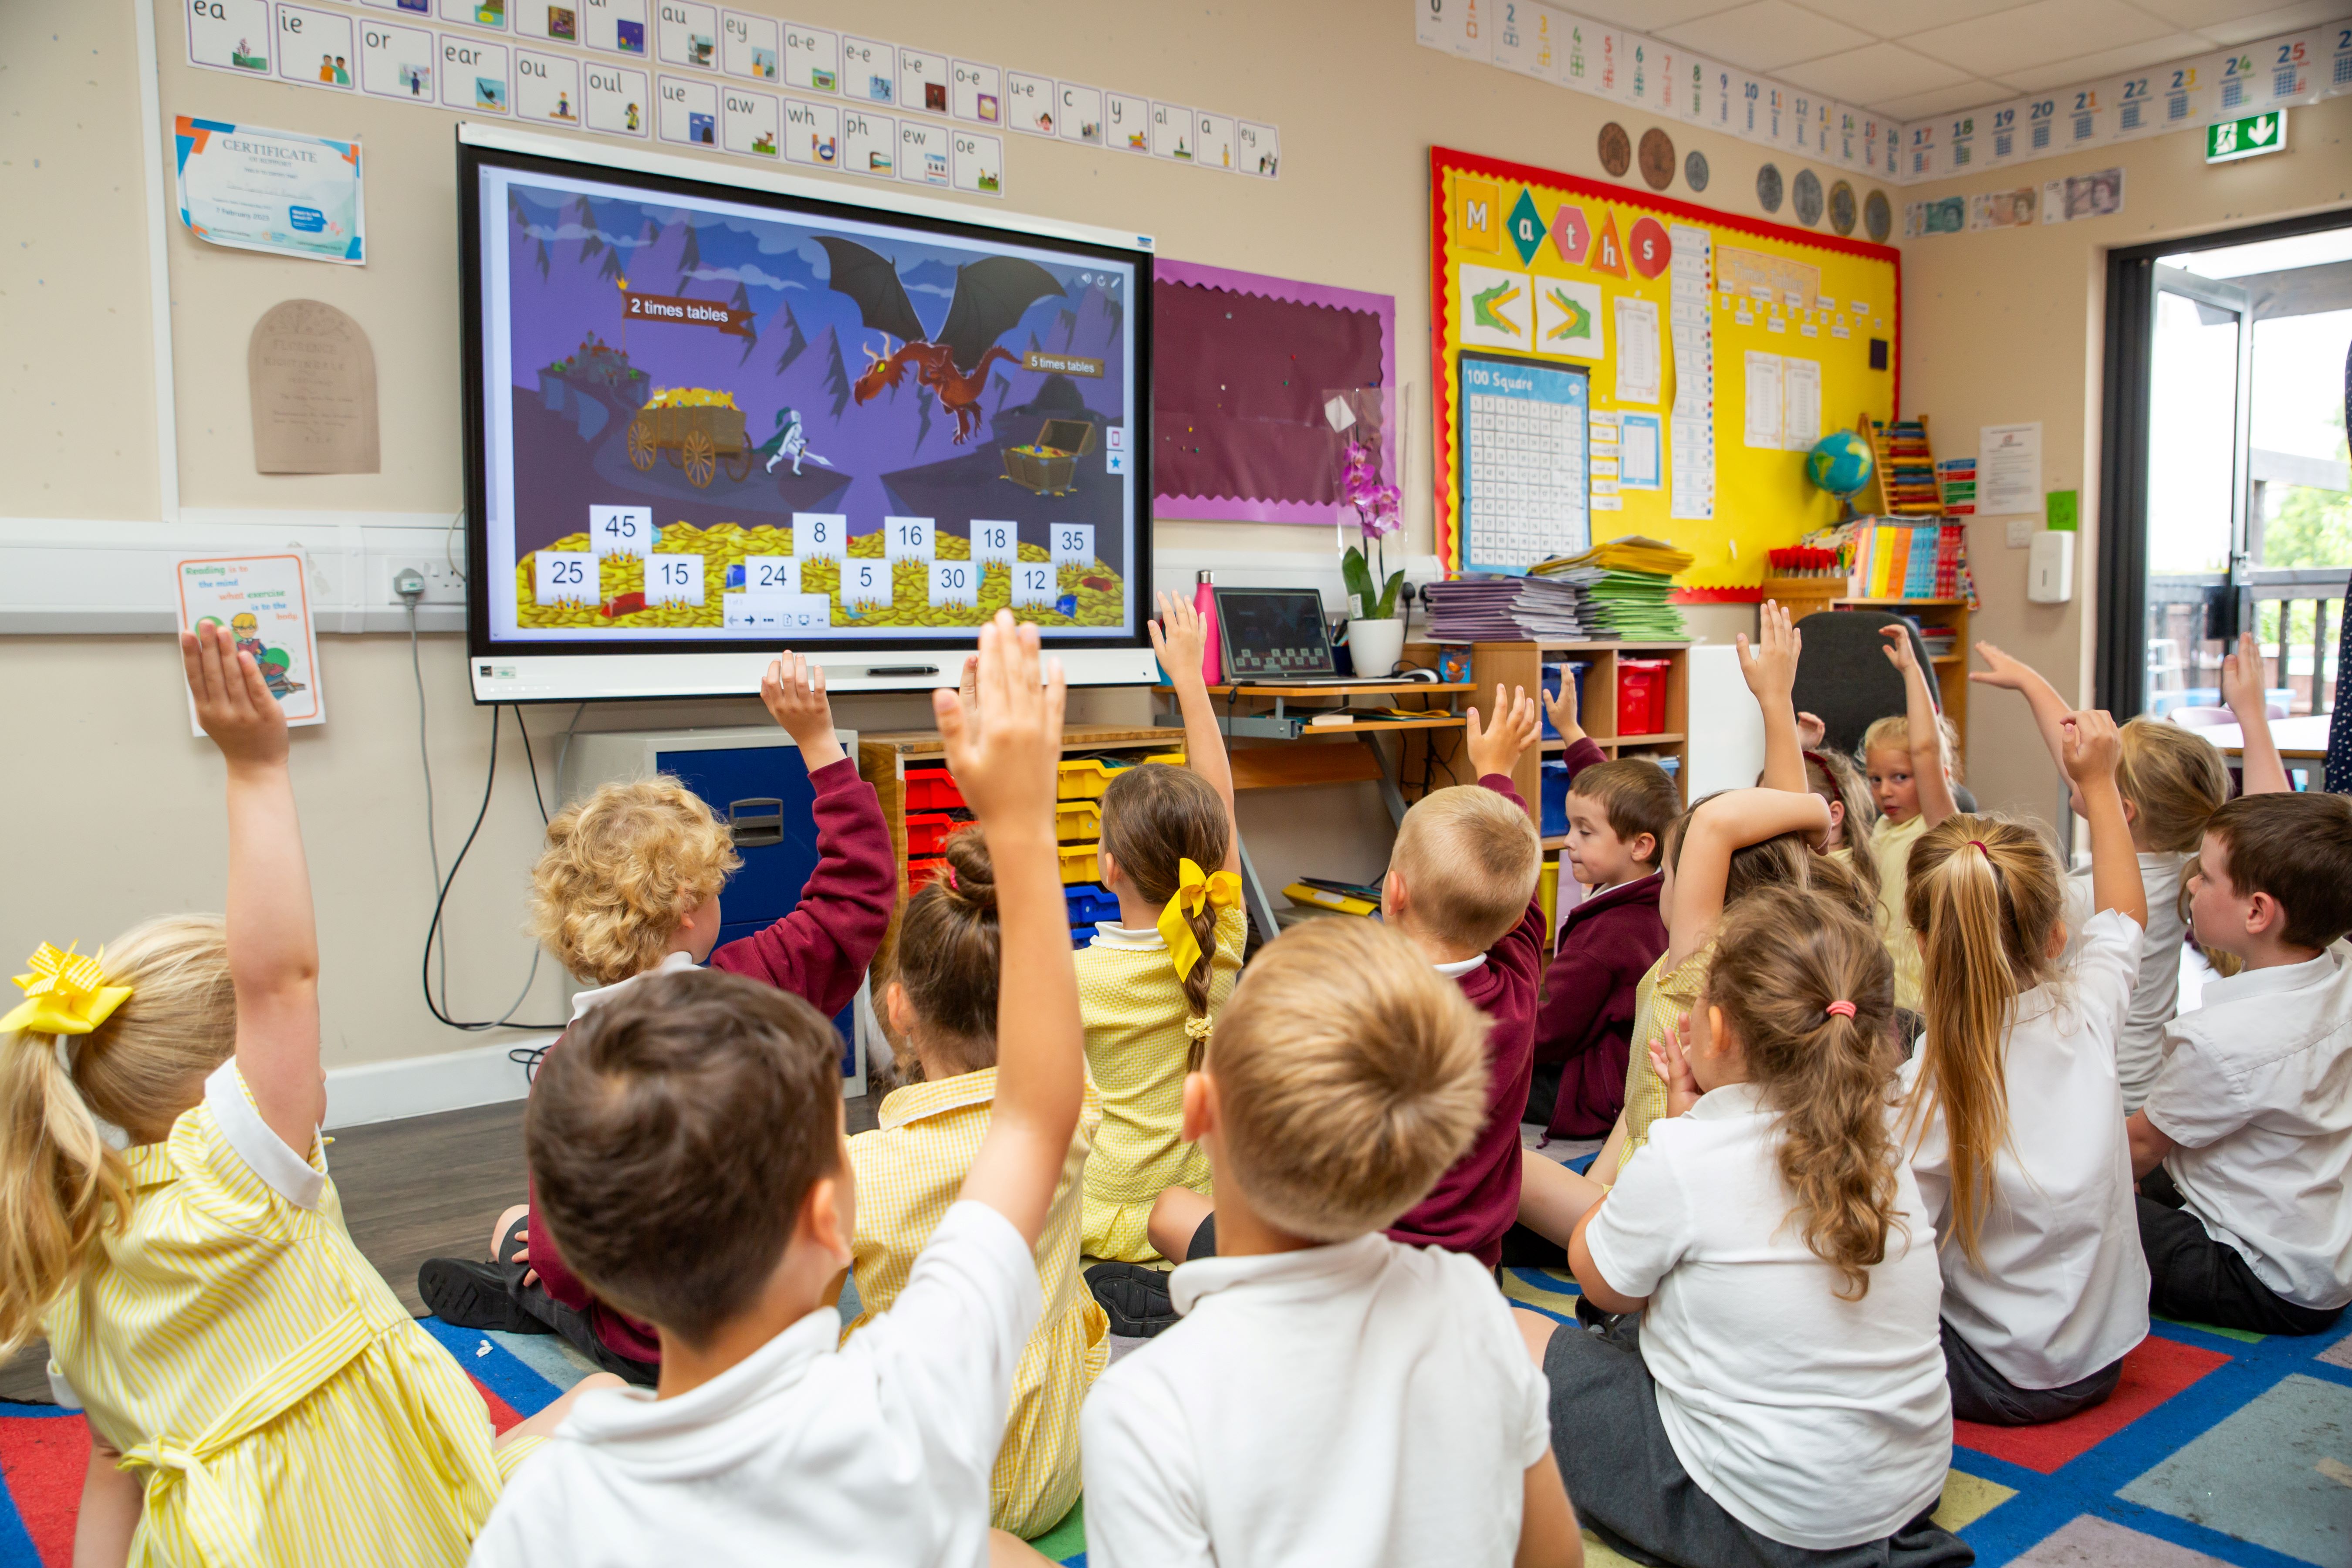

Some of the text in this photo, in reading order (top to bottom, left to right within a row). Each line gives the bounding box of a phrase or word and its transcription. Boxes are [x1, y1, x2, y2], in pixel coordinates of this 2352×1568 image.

[194, 0, 226, 20] ea
[662, 7, 688, 25] au
[1507, 3, 1515, 23] 2
[281, 10, 303, 34] ie
[726, 17, 747, 43] ey
[1541, 15, 1548, 34] 3
[365, 32, 391, 50] or
[788, 34, 815, 51] a-e
[1573, 26, 1581, 44] 4
[1605, 35, 1612, 54] 5
[2338, 30, 2352, 49] 2
[445, 46, 481, 66] ear
[846, 45, 871, 62] e-e
[1636, 45, 1644, 64] 6
[2277, 42, 2305, 63] 25
[520, 60, 547, 79] ou
[902, 53, 922, 73] i-e
[1664, 55, 1671, 72] 7
[1693, 64, 1700, 81] 8
[2225, 54, 2251, 76] 24
[590, 72, 623, 93] oul
[956, 69, 980, 85] o-e
[1720, 72, 1728, 89] 9
[2171, 68, 2196, 88] 23
[662, 84, 685, 103] ue
[1010, 81, 1034, 98] u-e
[1745, 81, 1758, 100] 10
[2123, 78, 2148, 99] 22
[727, 97, 754, 115] aw
[1064, 90, 1073, 107] c
[2075, 91, 2097, 110] 21
[787, 106, 815, 126] wh
[1112, 100, 1122, 124] y
[1155, 107, 1168, 125] al
[1994, 108, 2015, 128] 19
[2031, 100, 2054, 120] 20
[846, 116, 868, 139] ph
[1201, 119, 1212, 135] a
[1914, 128, 1932, 145] 17
[1953, 118, 1974, 138] 18
[903, 130, 926, 145] ew
[956, 139, 975, 154] oe
[1241, 127, 1256, 148] ey
[223, 139, 317, 163] CERTIFICATE
[1467, 199, 1654, 267] Maths
[1733, 262, 1803, 292] Times Tables
[631, 298, 729, 323] 2 times tables
[1031, 356, 1095, 373] 5 times tables
[1467, 369, 1533, 392] 100 Square
[605, 515, 636, 537] 45
[814, 523, 826, 542] 8
[899, 525, 922, 546] 16
[984, 529, 1006, 548] 18
[1062, 531, 1084, 550] 35
[186, 567, 225, 575] Reading
[552, 561, 583, 584] 25
[661, 563, 689, 585] 15
[760, 565, 787, 586] 24
[860, 567, 872, 587] 5
[941, 569, 965, 588] 30
[1024, 571, 1045, 590] 12
[247, 590, 286, 598] exercise
